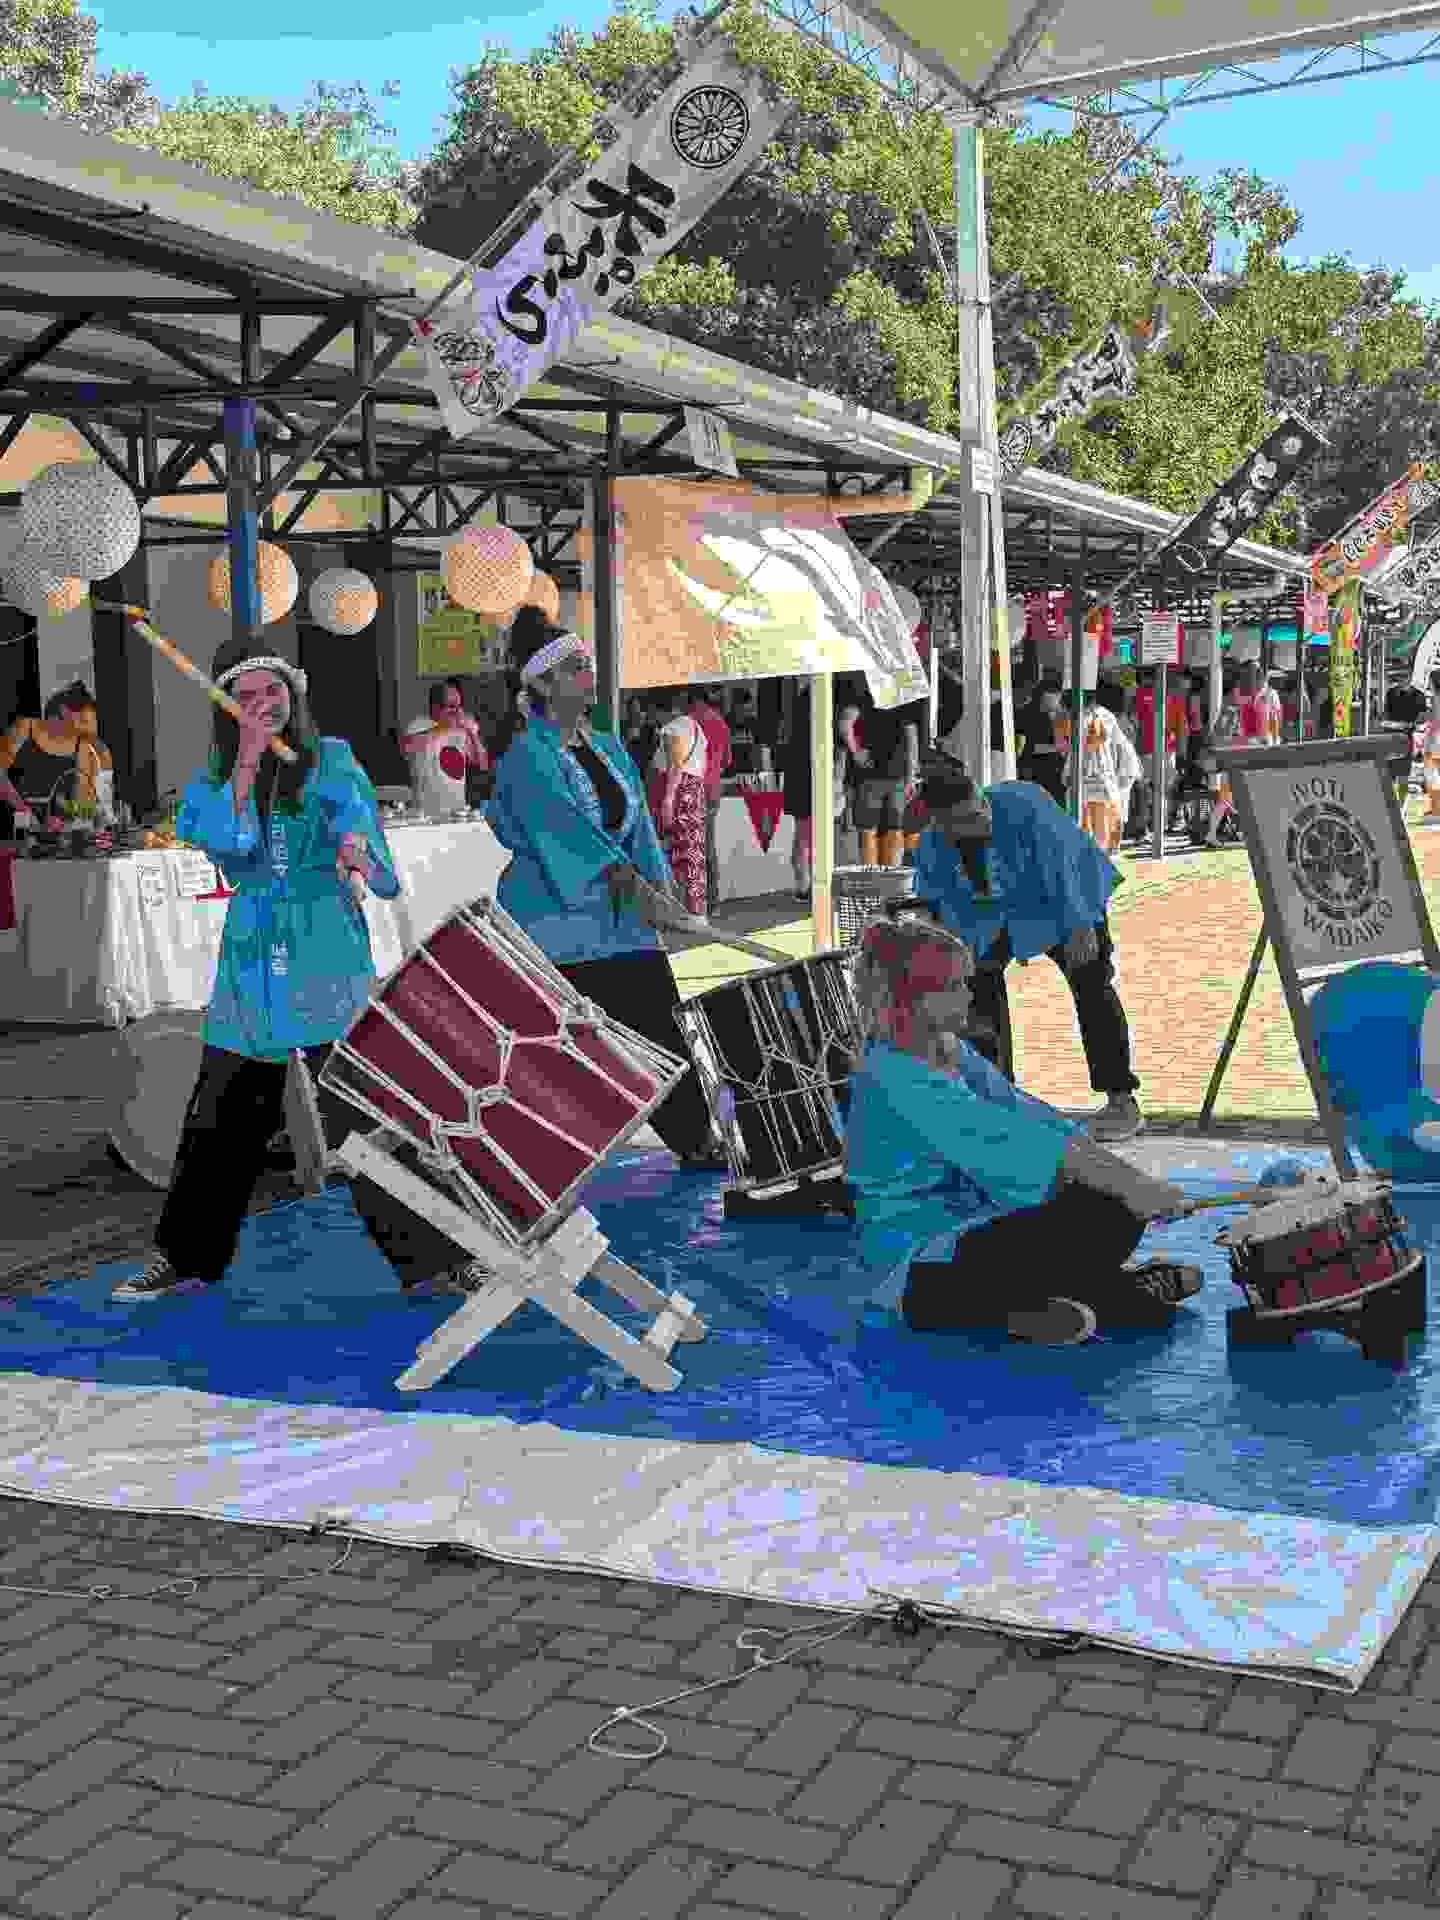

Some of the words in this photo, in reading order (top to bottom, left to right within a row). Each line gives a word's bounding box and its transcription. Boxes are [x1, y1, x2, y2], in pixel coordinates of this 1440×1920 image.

[497, 163, 675, 344] 天ぷら
[1303, 898, 1393, 946] WADAIKO
